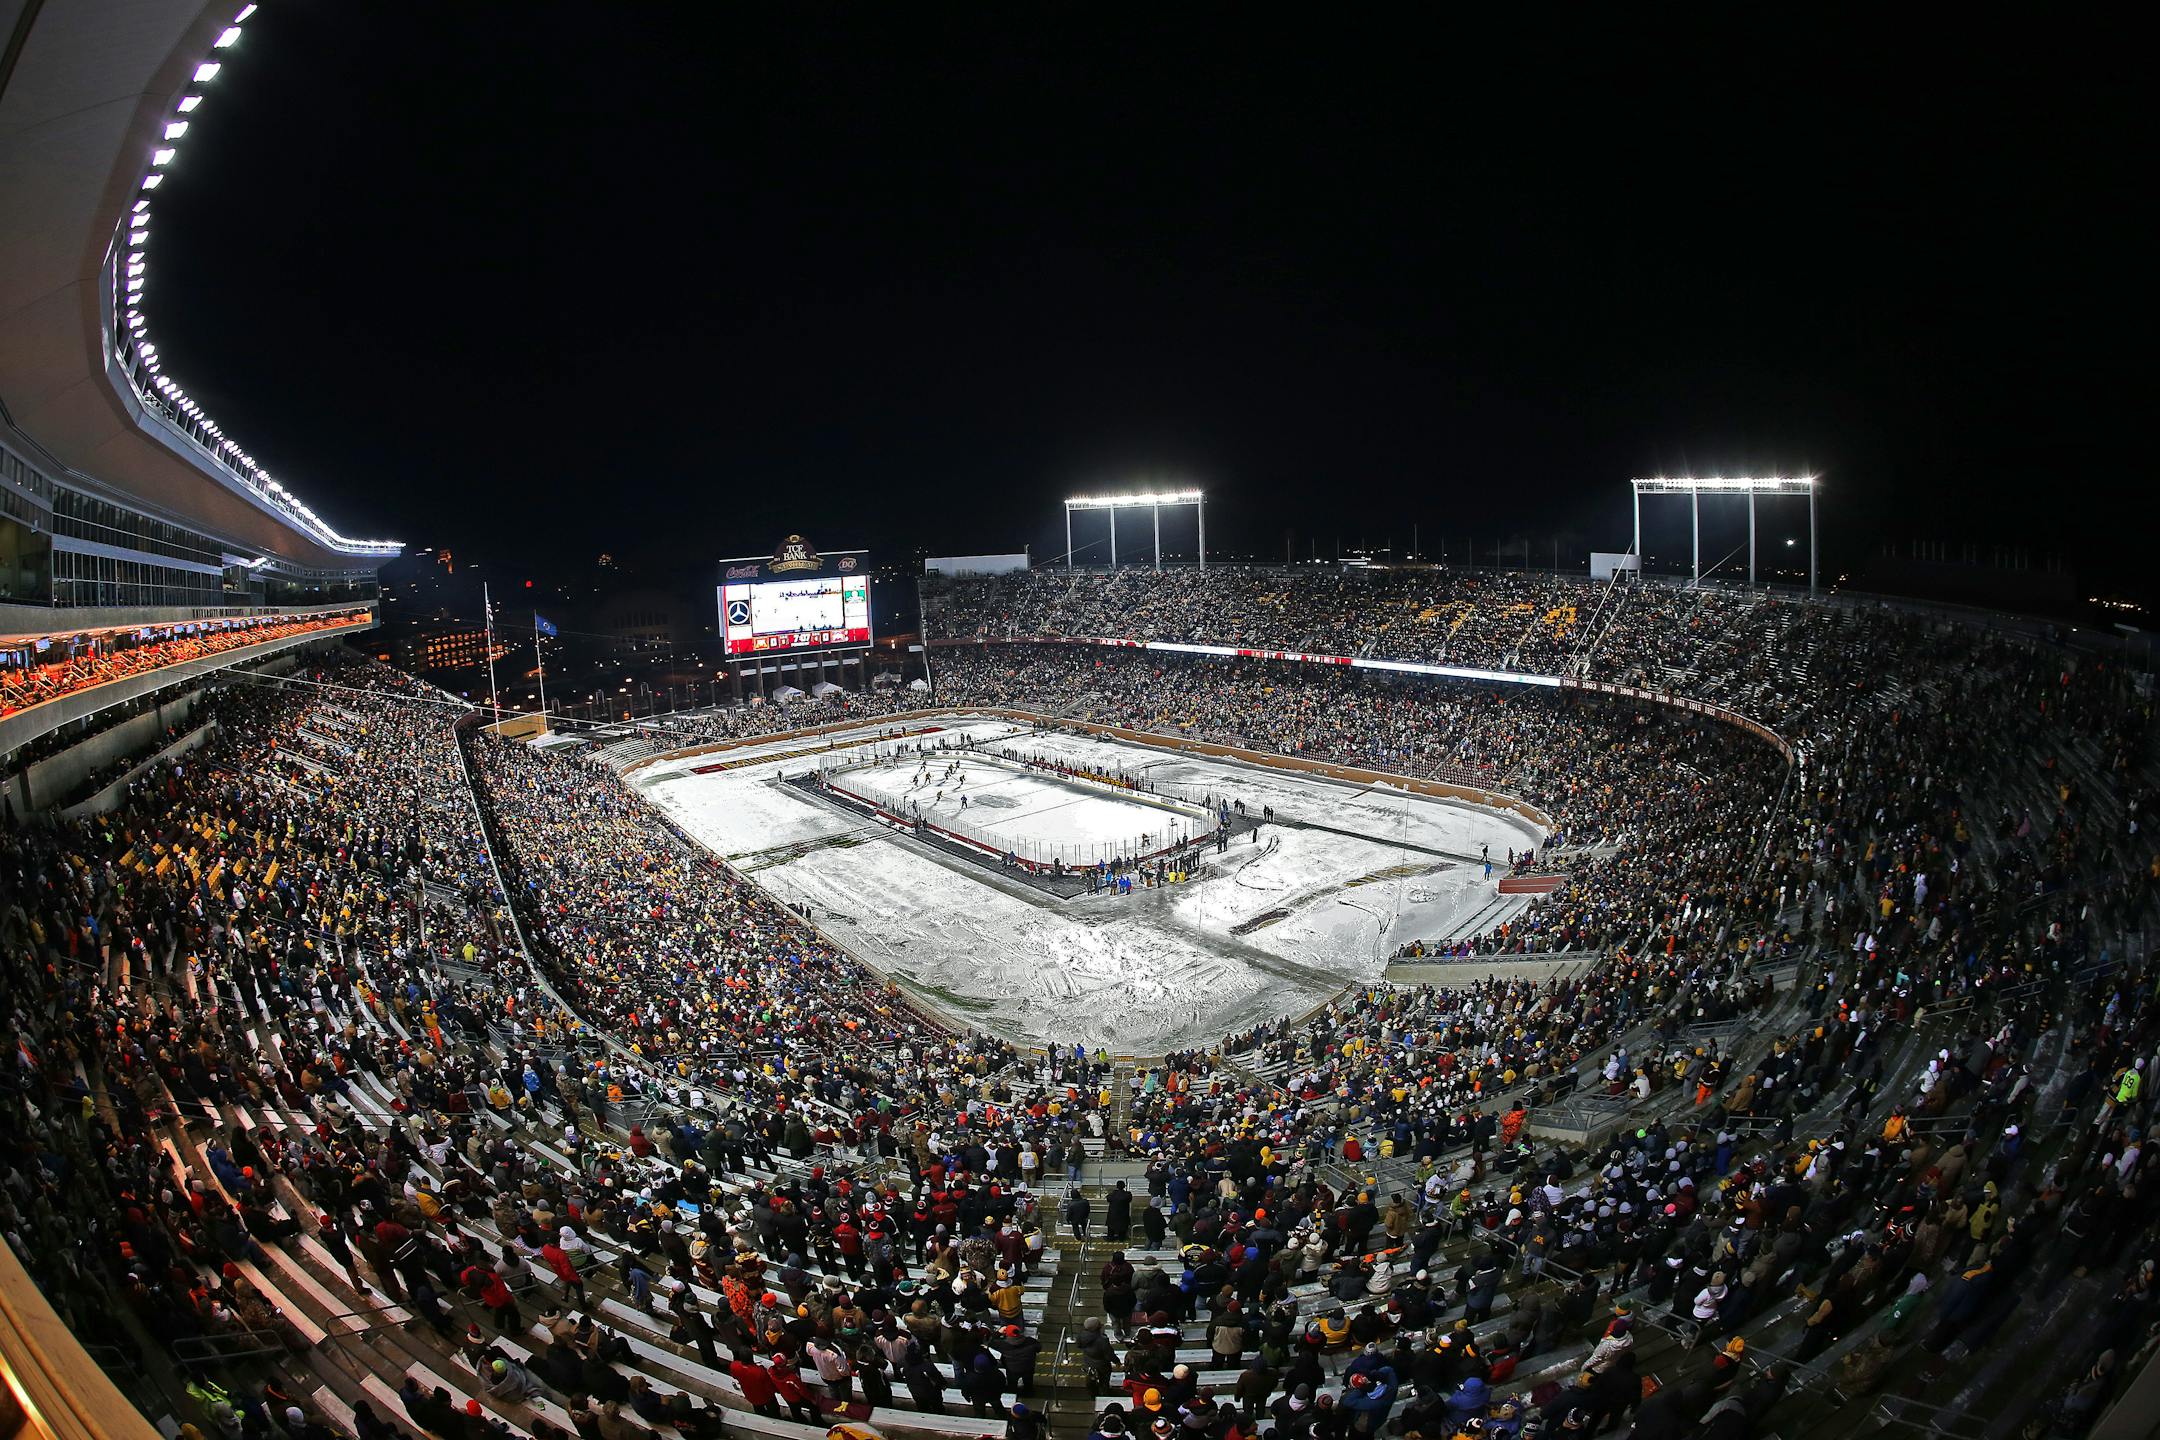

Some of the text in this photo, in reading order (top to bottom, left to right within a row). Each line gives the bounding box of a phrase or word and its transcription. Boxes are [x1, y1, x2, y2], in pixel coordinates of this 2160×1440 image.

[786, 545, 803, 554] TCF
[783, 552, 807, 561] BANK
[1563, 679, 1577, 688] 1900
[1582, 681, 1597, 690] 1903
[1601, 684, 1615, 693] 1904
[1620, 687, 1634, 696] 1906
[1638, 690, 1652, 700] 1909
[1656, 694, 1669, 703] 1910
[1673, 697, 1685, 707] 1911
[1689, 701, 1701, 712] 1915
